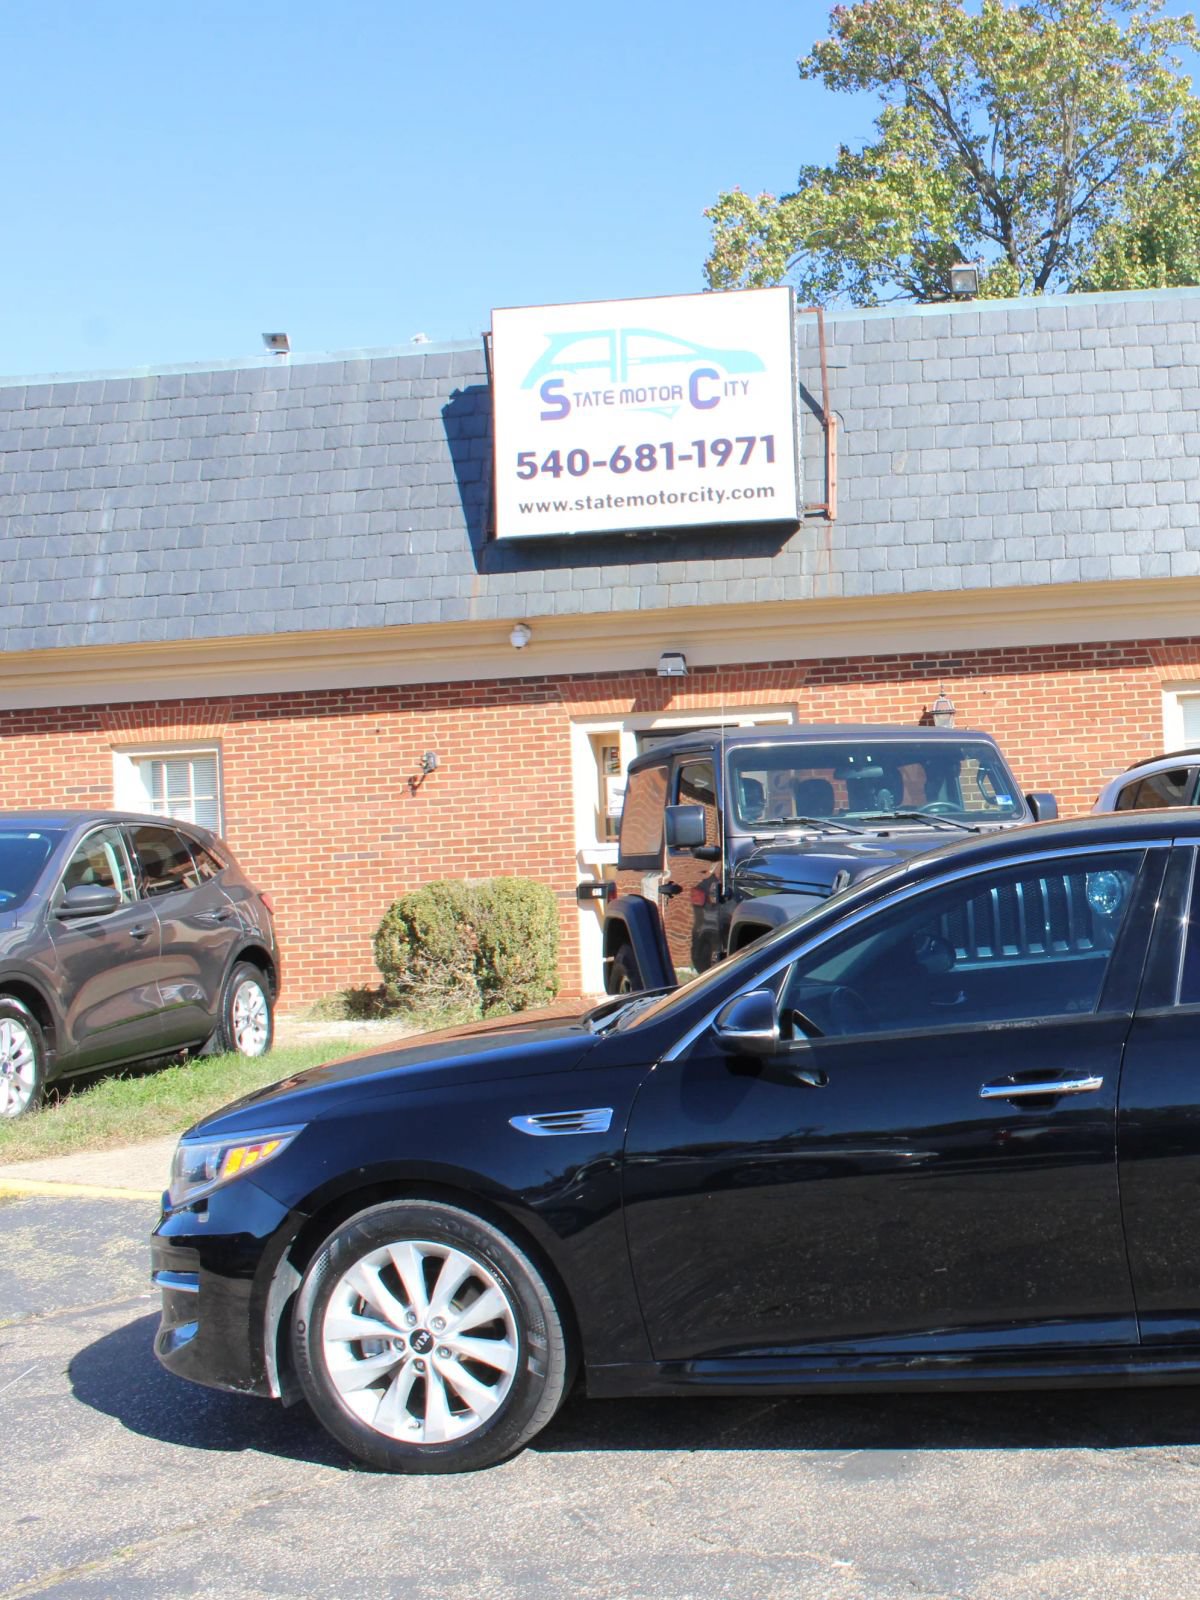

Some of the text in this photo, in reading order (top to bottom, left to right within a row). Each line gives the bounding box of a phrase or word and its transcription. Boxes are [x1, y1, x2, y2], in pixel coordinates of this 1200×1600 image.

[619, 385, 683, 404] MOTOR
[689, 368, 750, 410] CITY
[516, 434, 775, 480] 540-681-1971
[518, 486, 775, 514] www.statemotorcity.com
[413, 1331, 430, 1351] KIA
